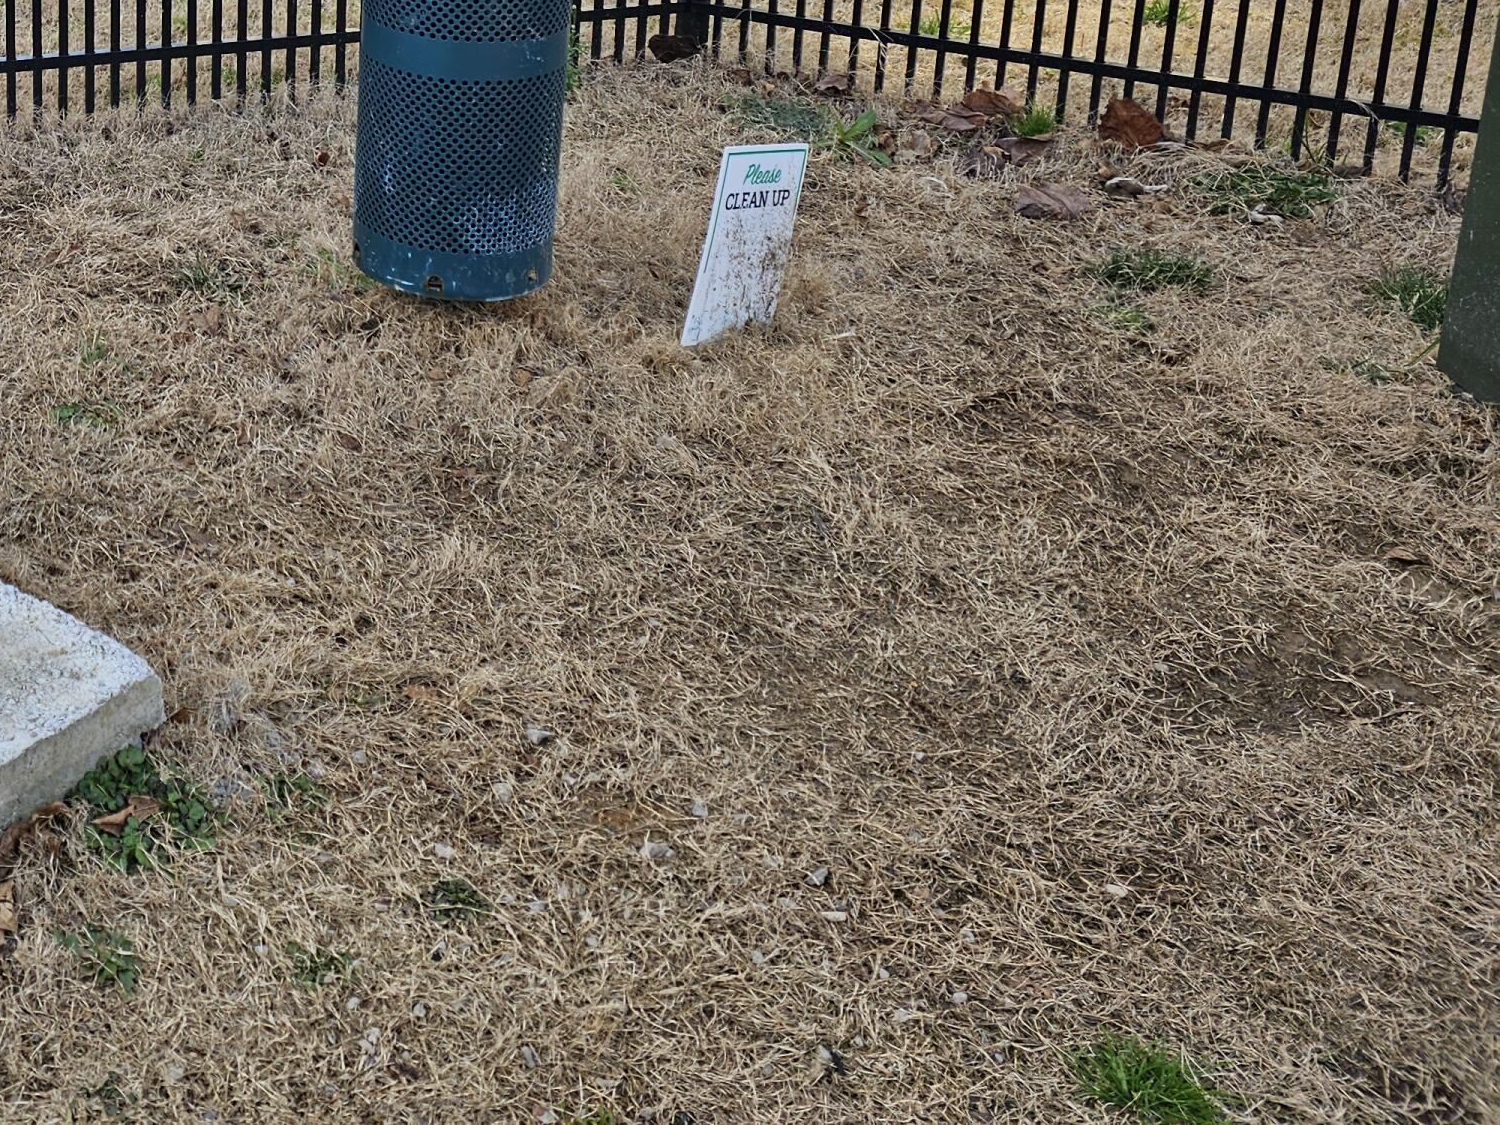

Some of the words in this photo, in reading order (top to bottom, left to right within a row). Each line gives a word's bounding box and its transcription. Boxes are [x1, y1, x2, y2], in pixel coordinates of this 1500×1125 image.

[743, 163, 781, 185] Please
[725, 190, 769, 211] CLEAN
[772, 189, 791, 207] UP
